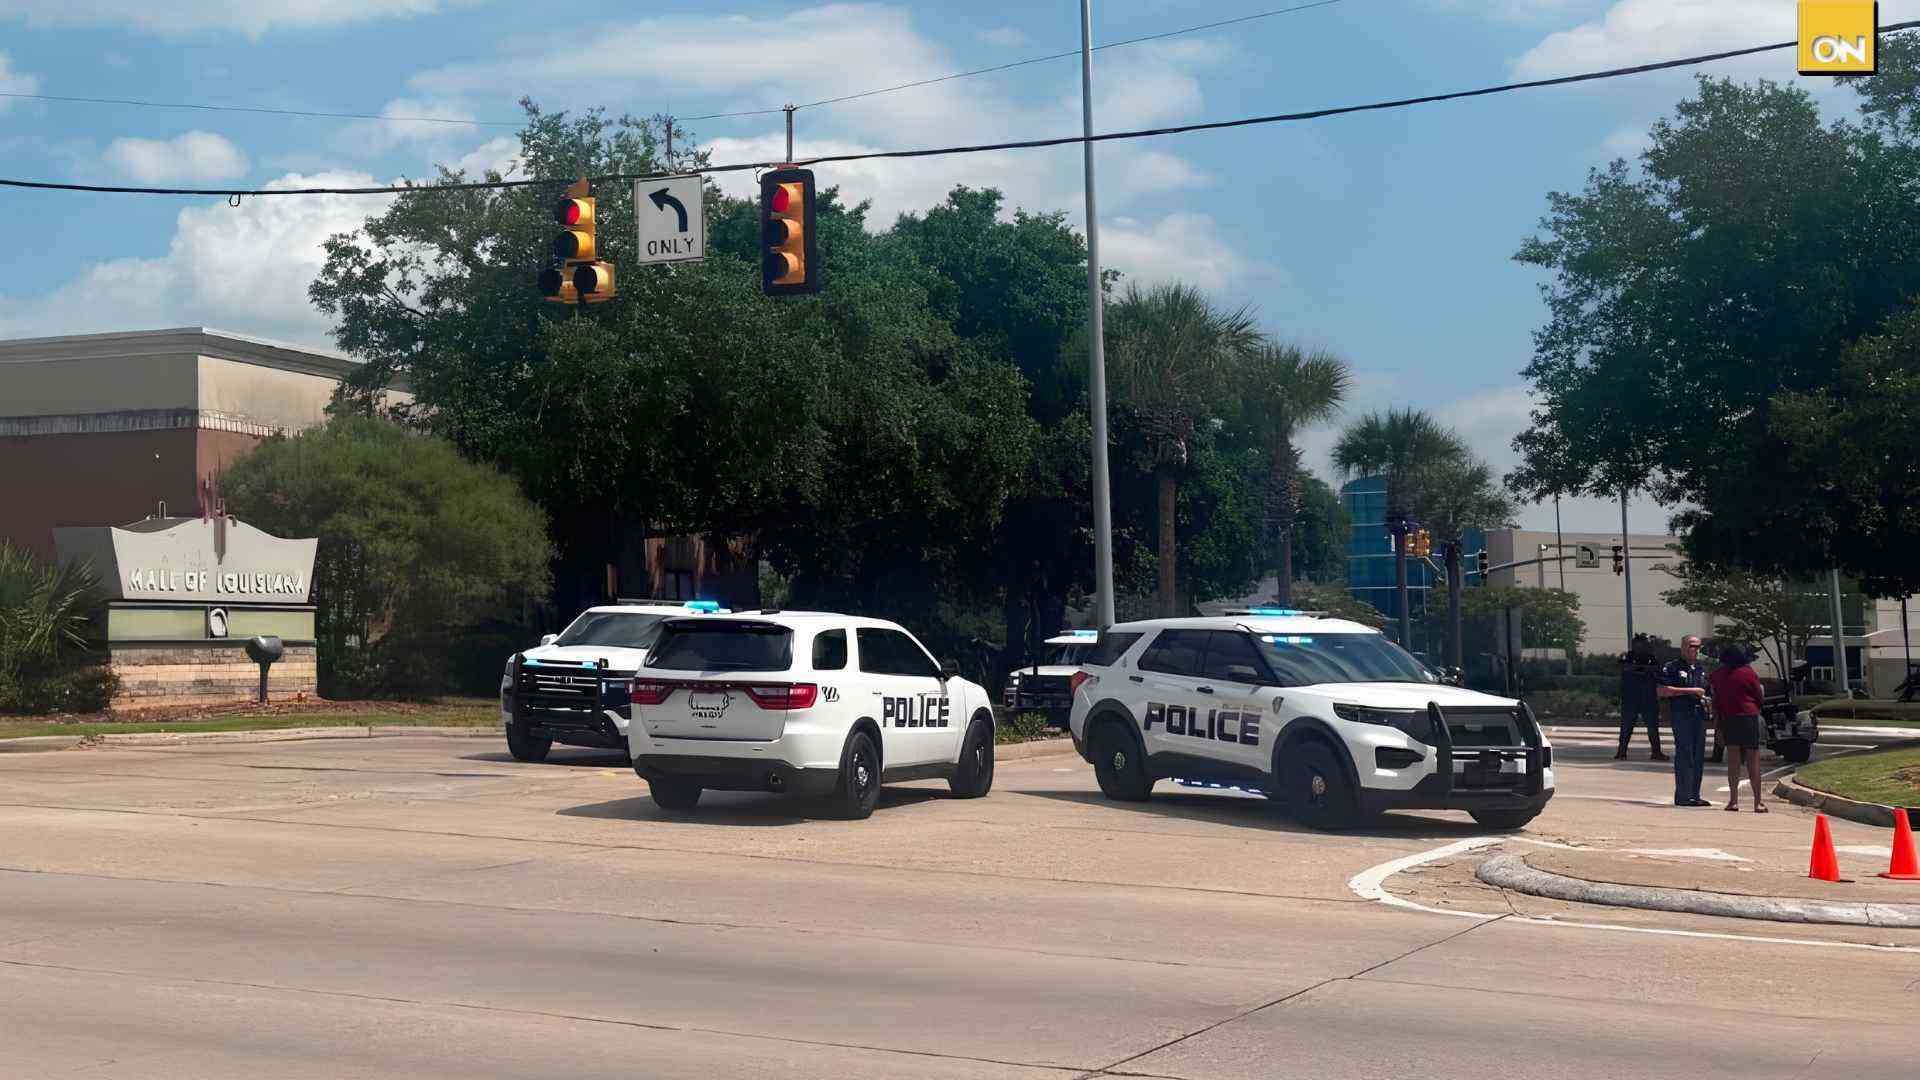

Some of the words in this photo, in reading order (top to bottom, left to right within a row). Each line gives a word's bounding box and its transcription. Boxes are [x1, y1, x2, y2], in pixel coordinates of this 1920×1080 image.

[648, 238, 694, 256] ONLY
[128, 569, 177, 592] MALL
[185, 569, 209, 592] OF
[216, 570, 307, 594] LOUISIANA
[882, 696, 949, 728] POLICE
[1144, 702, 1261, 745] POLICE
